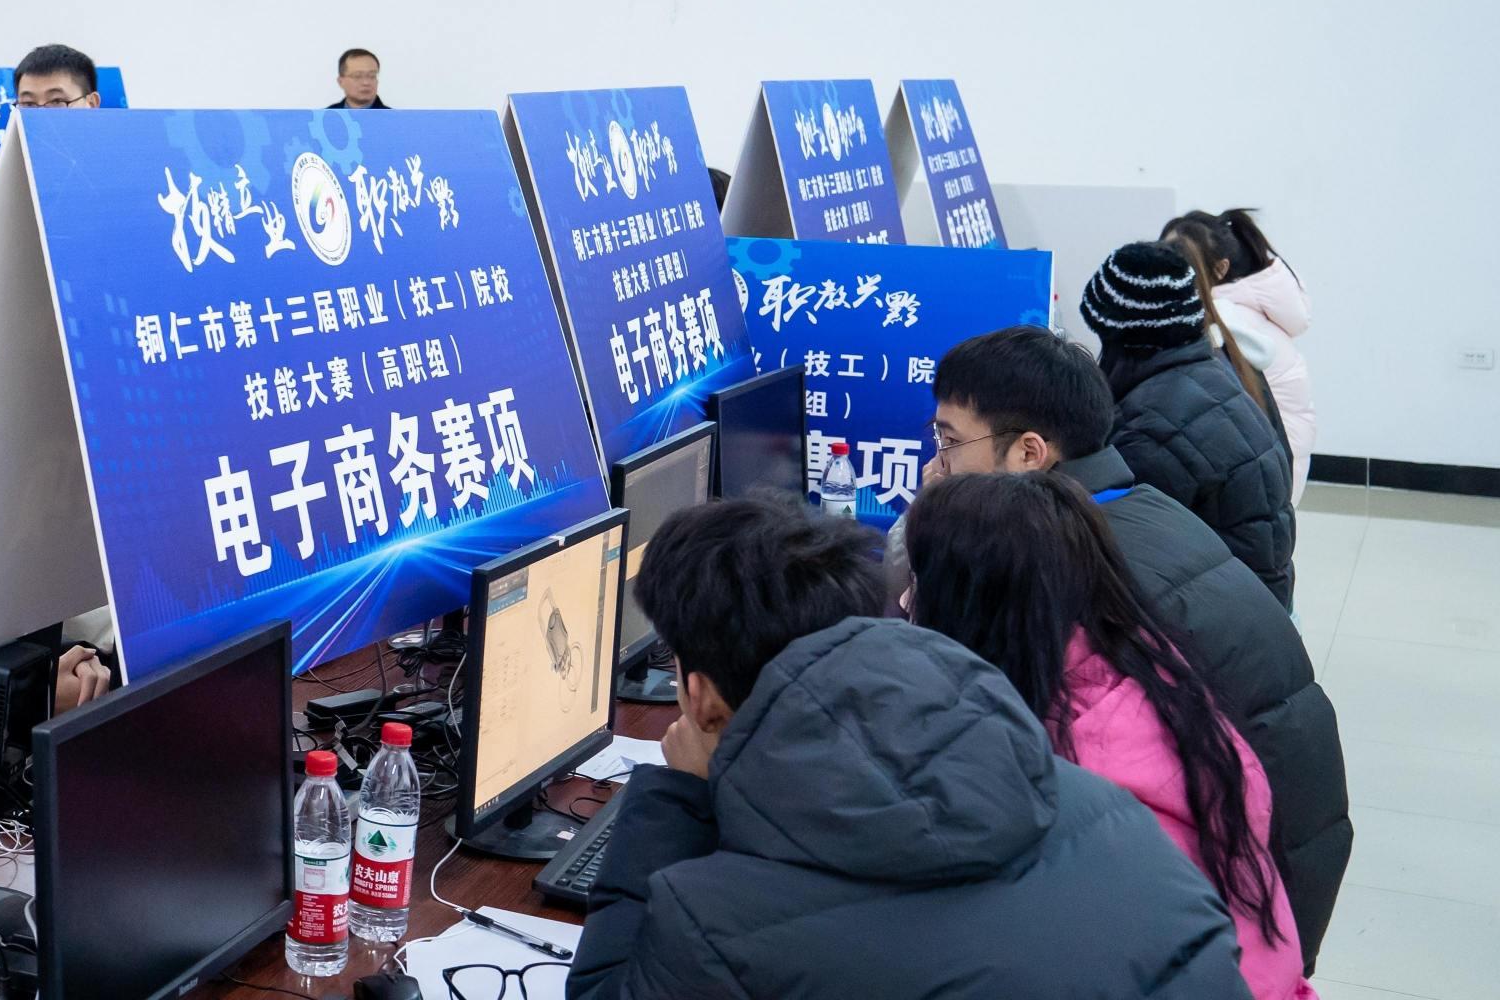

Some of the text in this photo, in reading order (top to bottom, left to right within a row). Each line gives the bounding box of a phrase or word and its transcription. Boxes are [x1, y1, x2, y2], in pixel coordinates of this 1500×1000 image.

[571, 199, 706, 262] 铜仁市第十三届职业（技工）院校
[134, 264, 514, 365] 铜仁市第十三届职业（技工）院校
[612, 248, 689, 302] 技能大赛（高职组）
[243, 334, 463, 422] 技能大赛（高职组）
[610, 287, 725, 405] 电子商务赛项
[203, 387, 536, 578] 电子商务赛项
[355, 863, 399, 885] 农夫山泉
